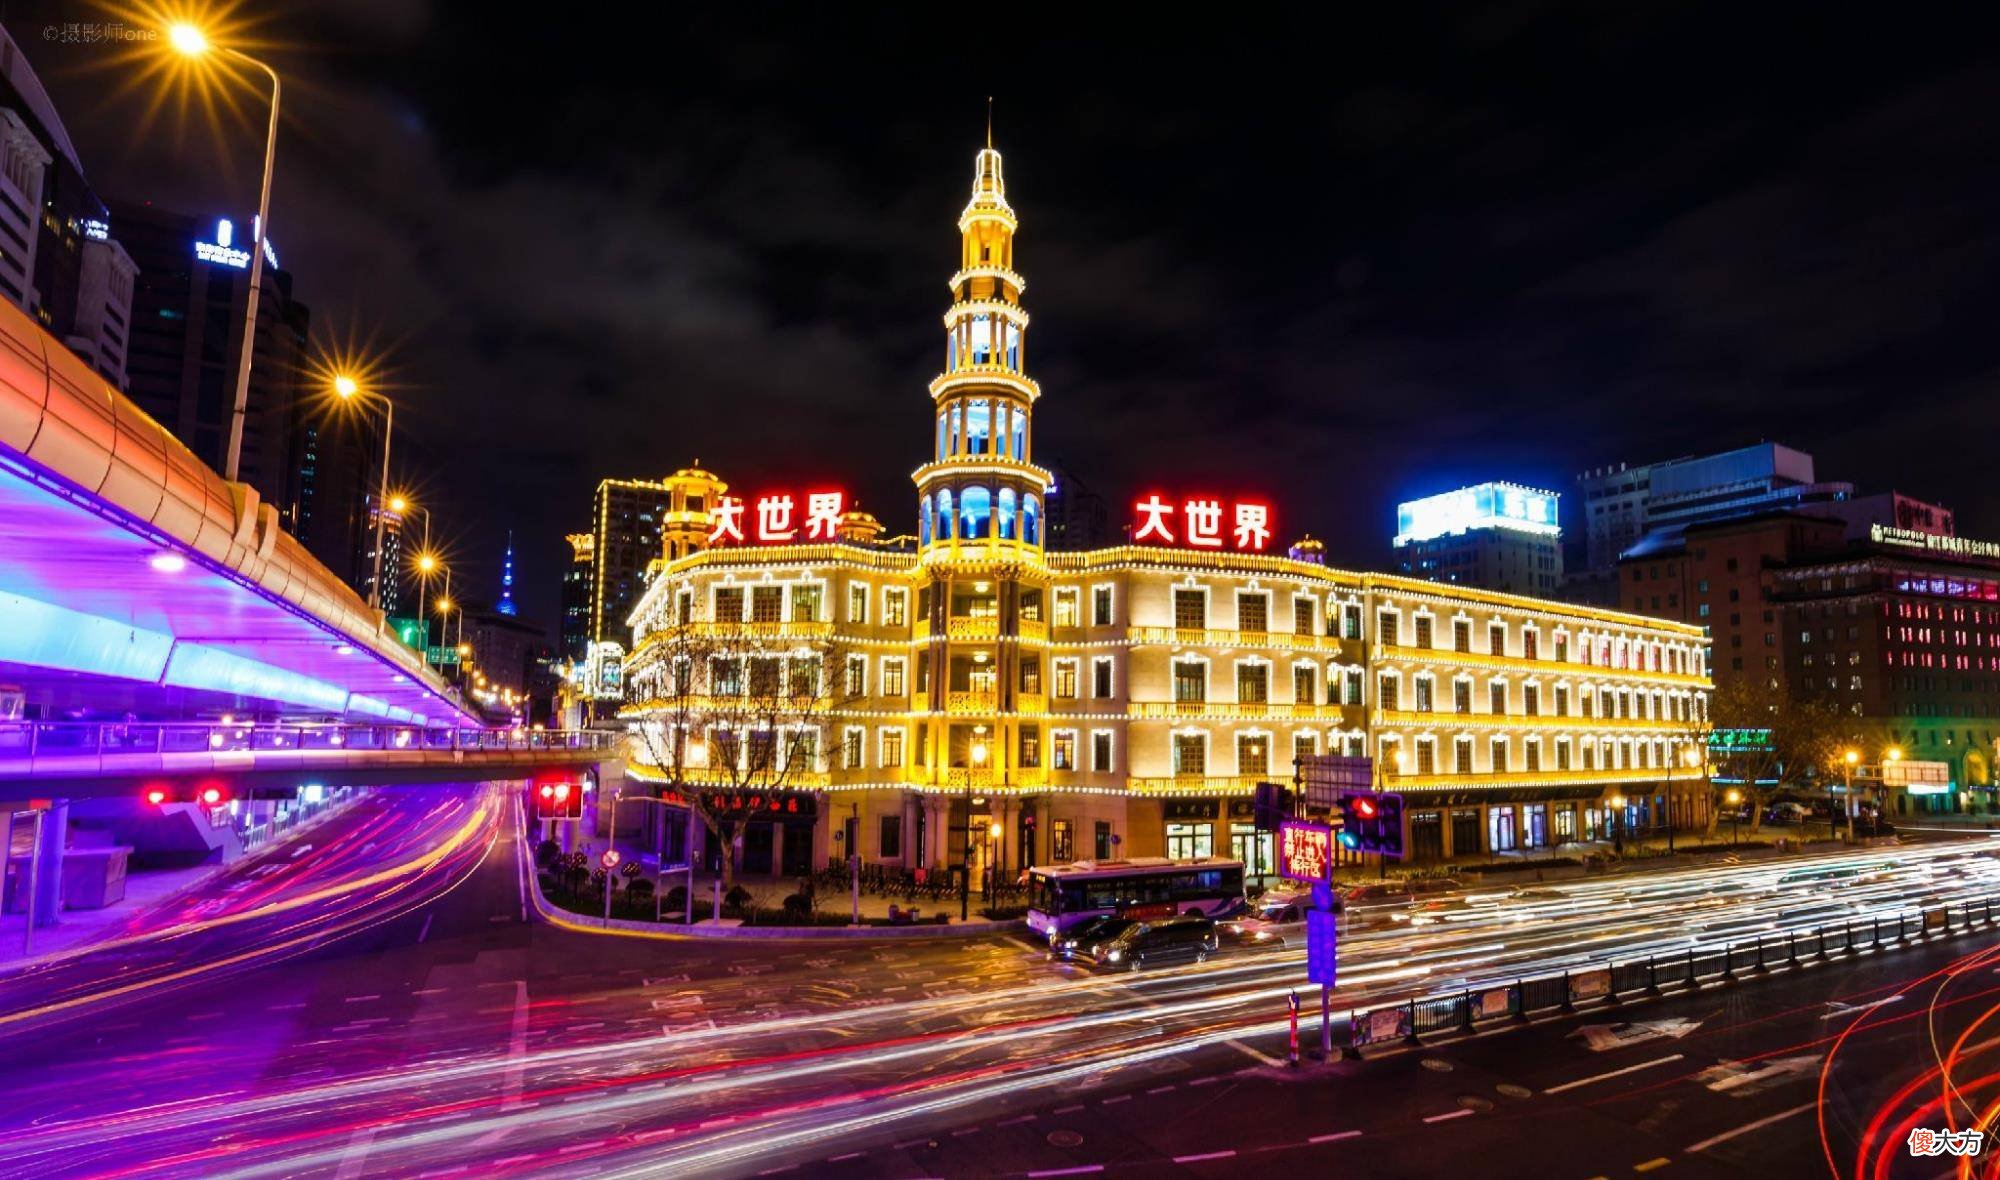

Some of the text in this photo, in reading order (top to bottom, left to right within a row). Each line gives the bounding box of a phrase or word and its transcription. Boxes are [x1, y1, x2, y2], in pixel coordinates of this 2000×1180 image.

[708, 492, 843, 542] 大世界
[1135, 496, 1270, 549] 大世界
